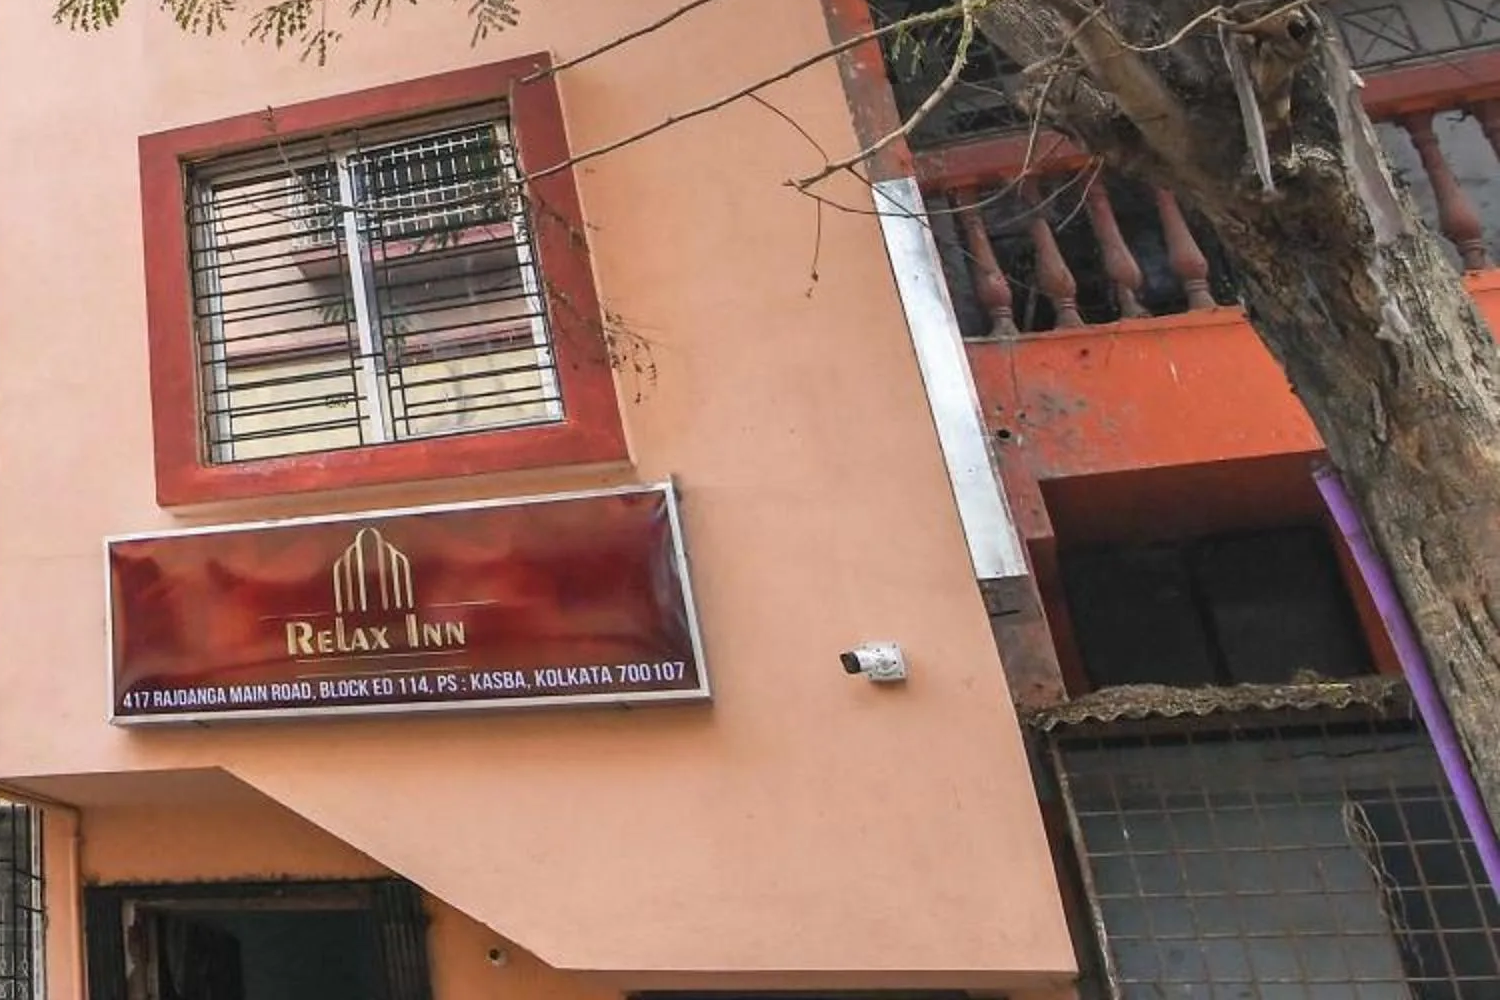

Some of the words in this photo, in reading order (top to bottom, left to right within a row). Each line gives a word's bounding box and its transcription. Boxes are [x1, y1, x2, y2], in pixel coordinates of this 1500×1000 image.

[123, 691, 149, 709] 417
[153, 687, 227, 708] RAJDANGA
[230, 685, 267, 705] MAIN
[319, 678, 369, 700] BLOCK
[372, 678, 393, 697] ED
[535, 665, 613, 688] KOLKATA
